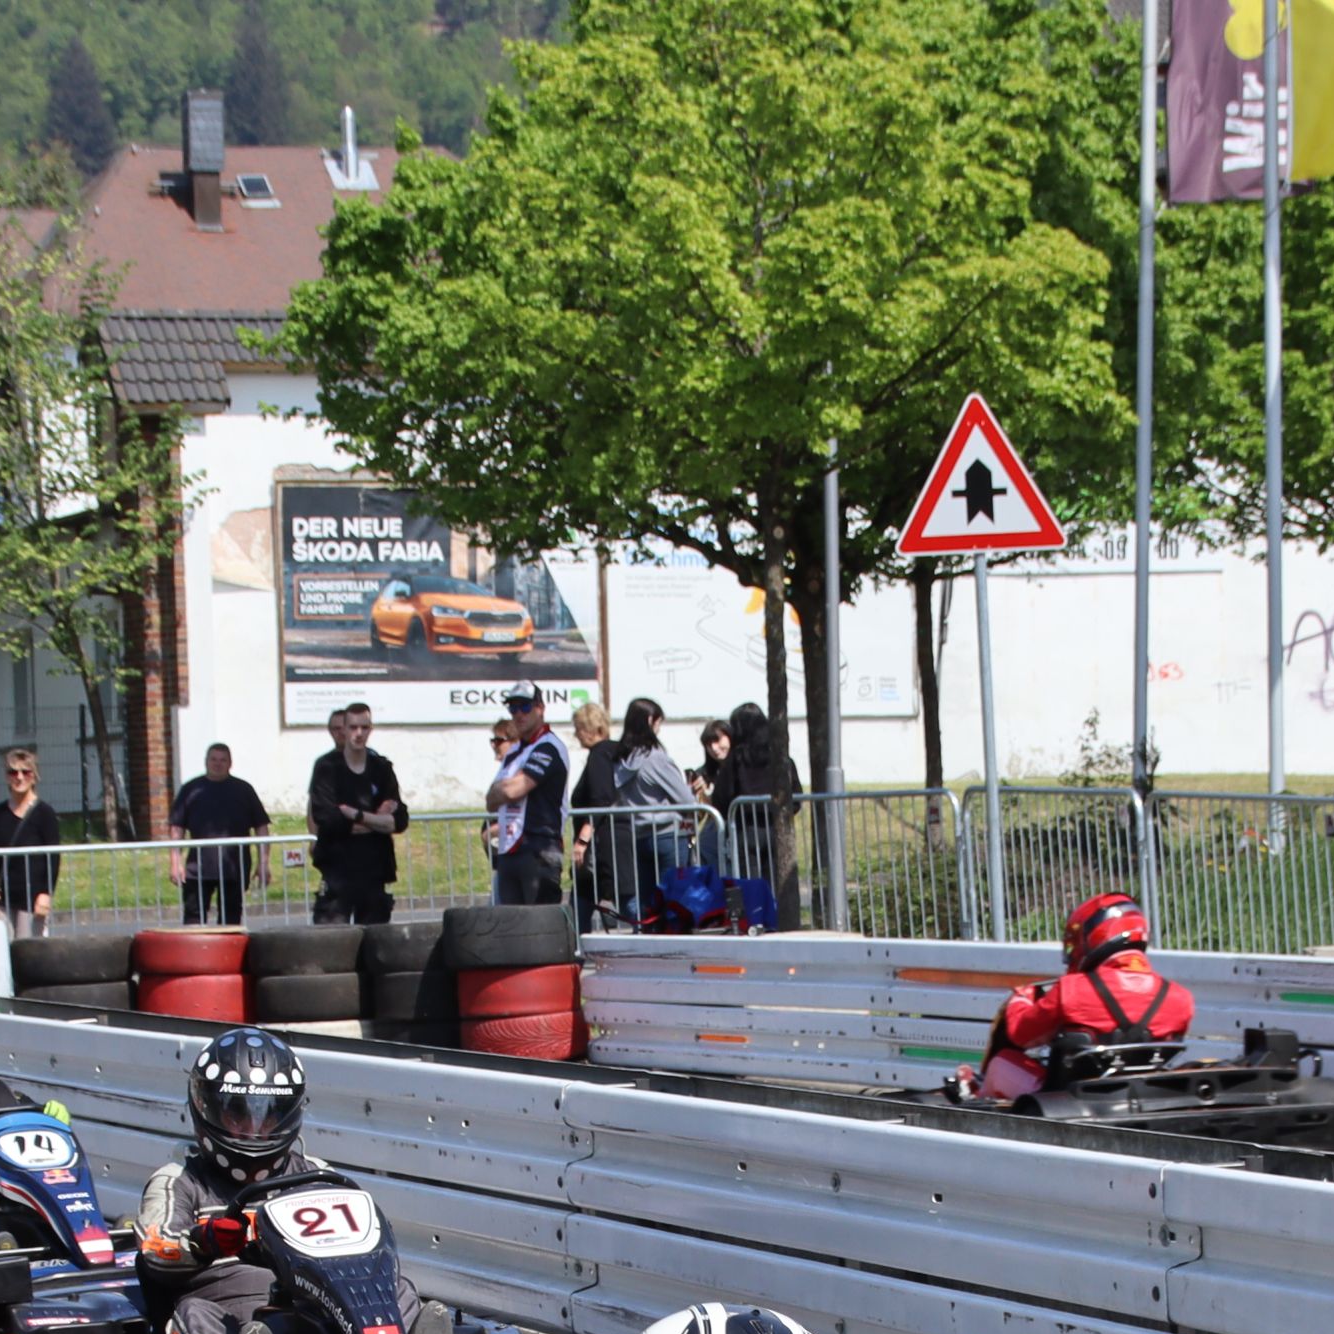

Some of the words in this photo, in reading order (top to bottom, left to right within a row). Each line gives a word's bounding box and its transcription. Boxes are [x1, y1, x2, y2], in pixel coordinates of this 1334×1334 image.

[292, 517, 338, 539] DER
[342, 517, 403, 539] NEUE
[292, 537, 374, 562] ŠKODA
[378, 540, 444, 562] FABIA
[299, 580, 379, 592] VORBESTELLEN
[299, 592, 325, 604] UND
[326, 592, 364, 604] PROBE
[299, 604, 345, 615] FAHREN
[450, 688, 568, 706] ECKSIN
[13, 1134, 59, 1156] 14
[292, 1203, 361, 1238] 21
